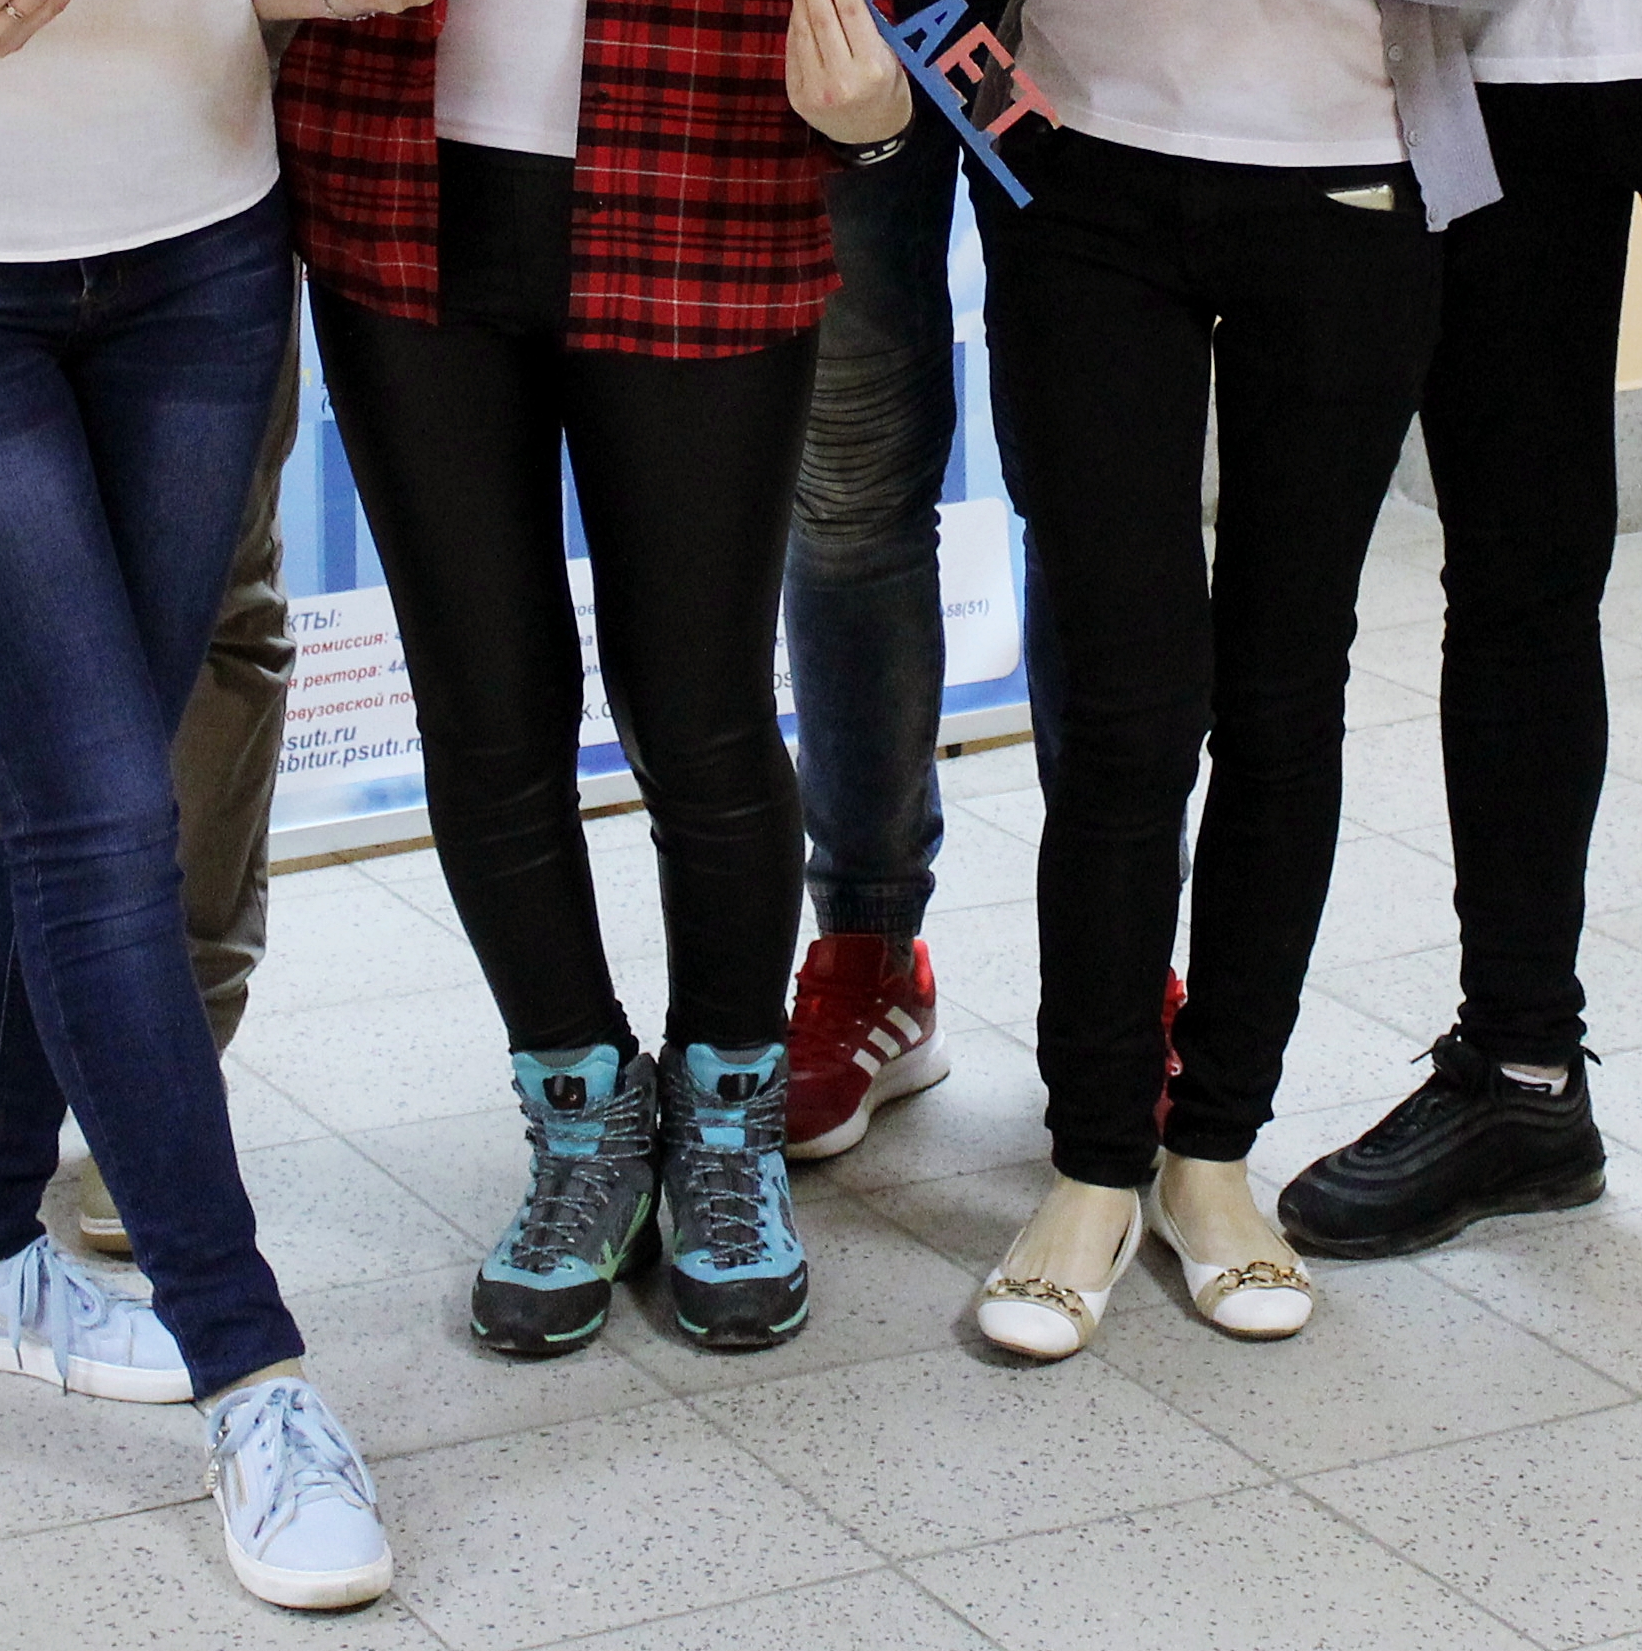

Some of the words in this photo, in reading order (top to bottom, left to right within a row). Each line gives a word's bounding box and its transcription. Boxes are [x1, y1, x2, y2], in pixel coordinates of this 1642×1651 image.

[301, 632, 389, 657] комиссия:
[303, 663, 383, 692] ректора:
[285, 692, 384, 723] овузовской
[281, 725, 357, 752] suti.ru
